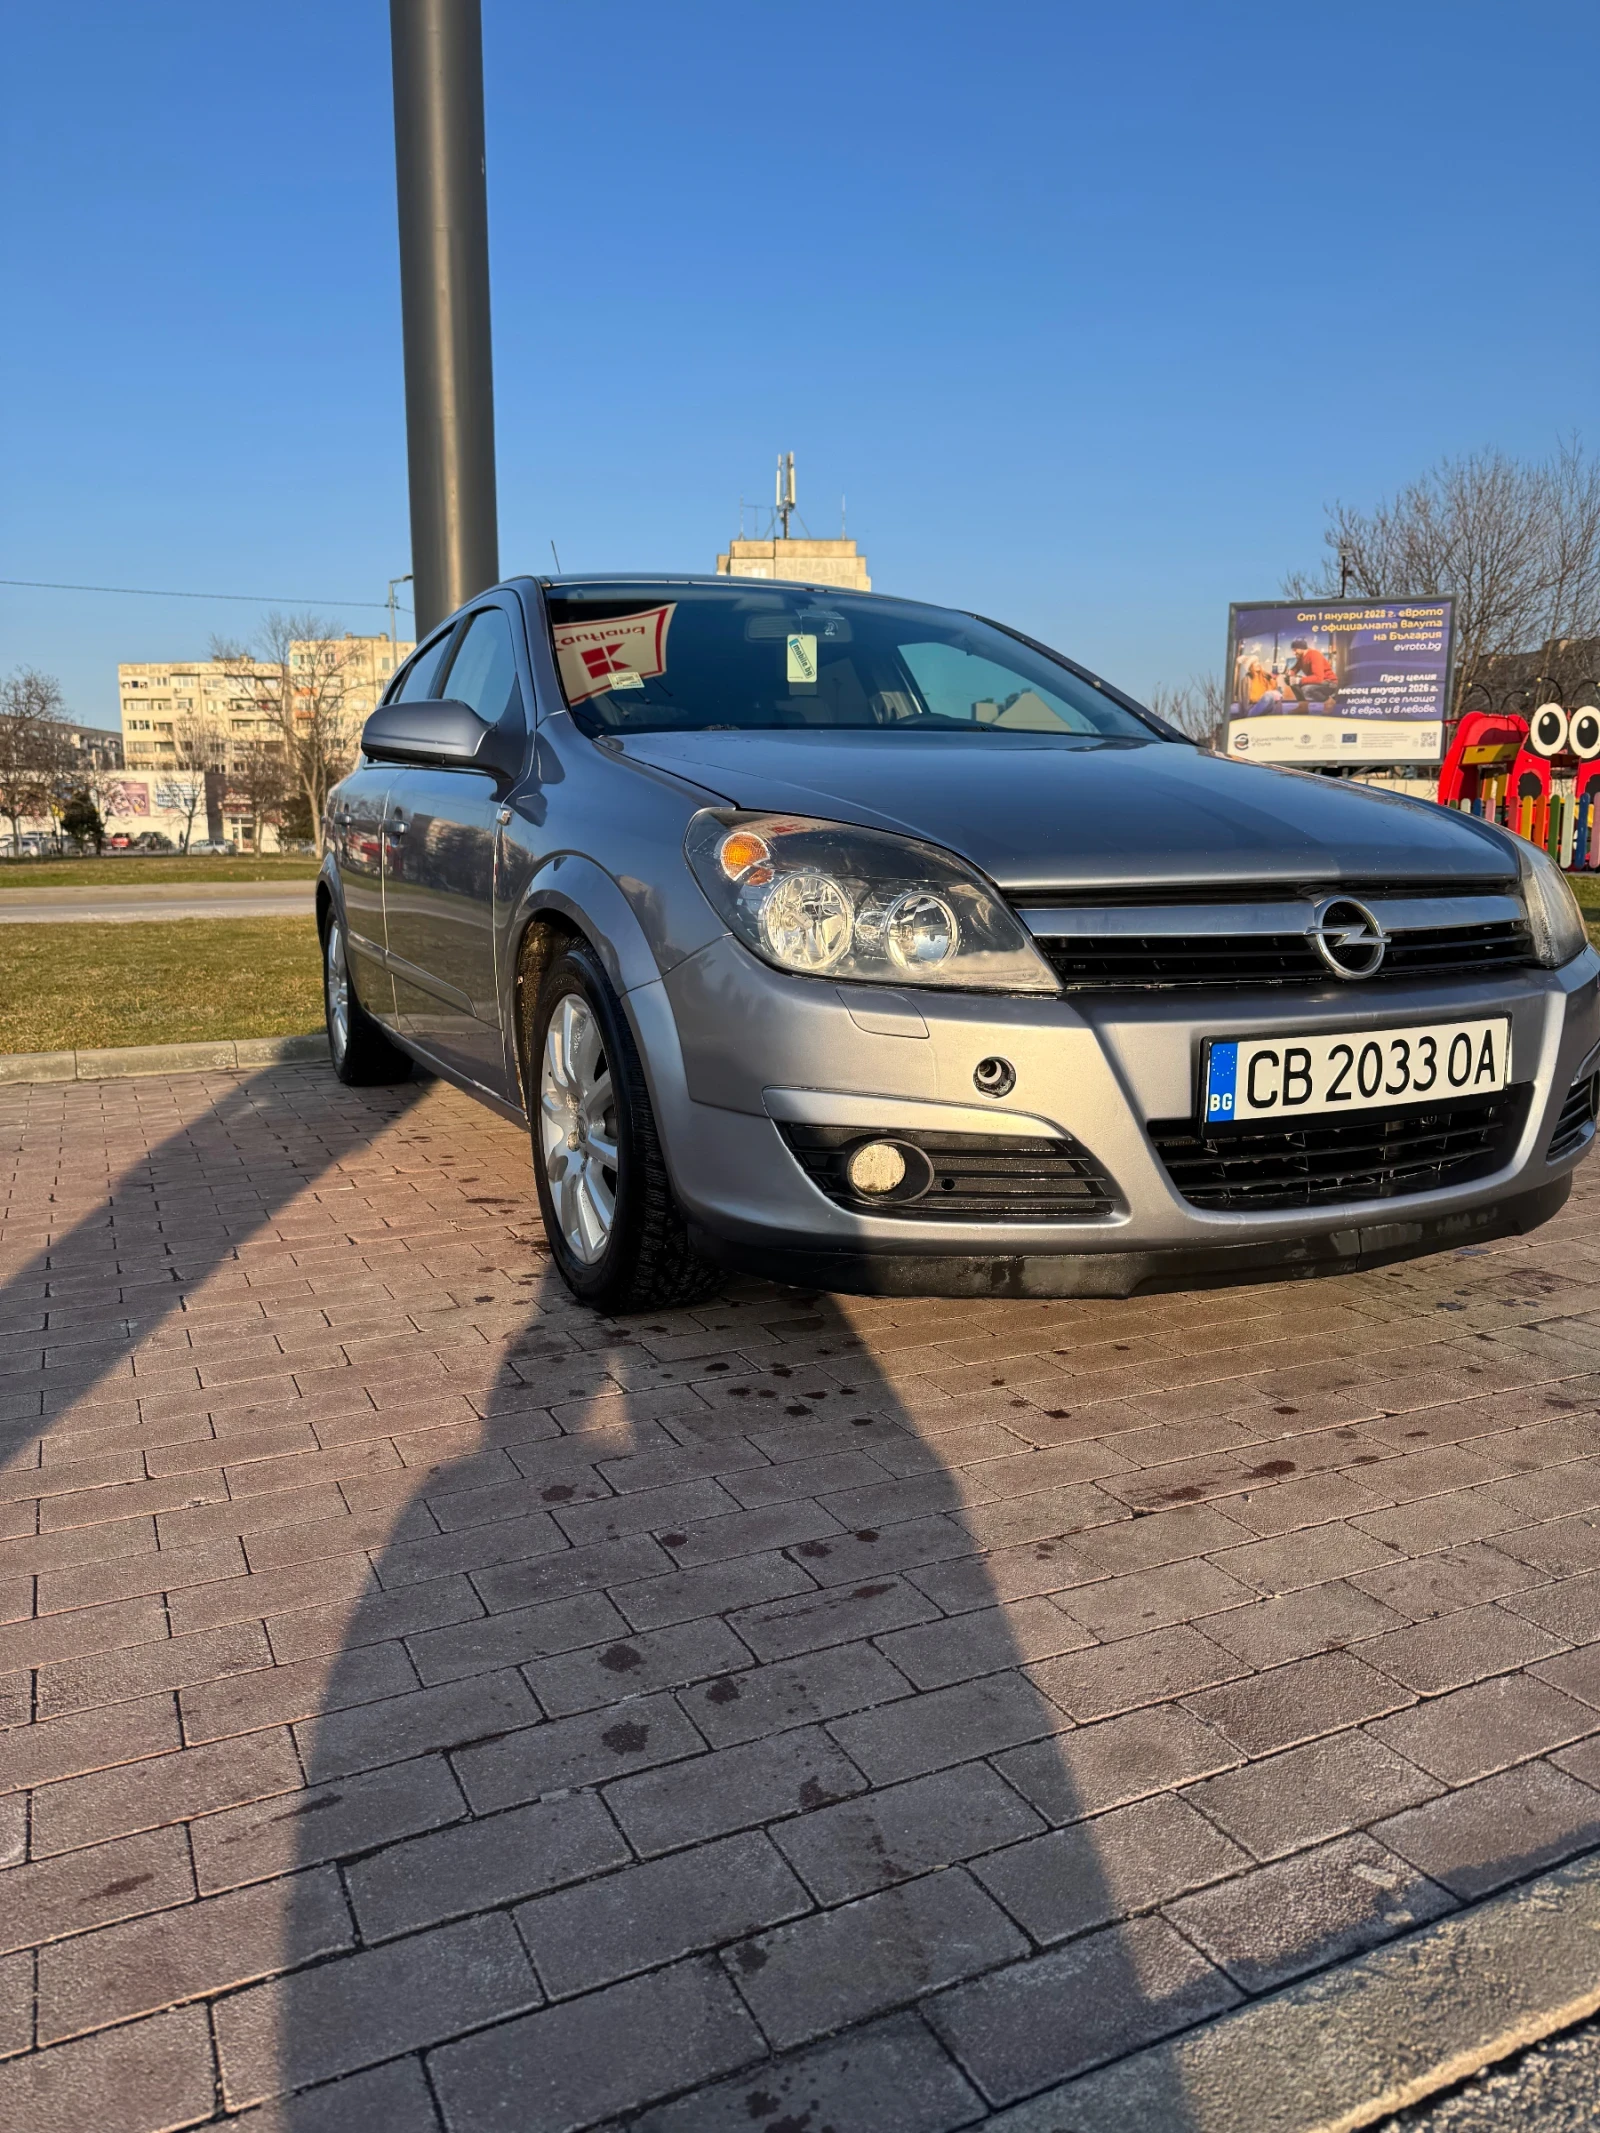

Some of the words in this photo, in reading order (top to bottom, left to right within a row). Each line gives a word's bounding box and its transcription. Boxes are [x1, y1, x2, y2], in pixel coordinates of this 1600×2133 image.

[1297, 613, 1316, 621] От
[1318, 612, 1323, 620] 1
[1324, 612, 1362, 622] януари
[1398, 608, 1443, 618] еврото
[1321, 622, 1398, 633] официалната
[1401, 619, 1442, 629] валута
[1389, 631, 1442, 641] България
[1394, 641, 1442, 651] evroto.bg
[793, 644, 813, 677] mobile.bg
[1380, 674, 1404, 683] През
[1406, 673, 1437, 682] целия
[1338, 687, 1369, 695] месец
[1370, 686, 1407, 695] януари
[1408, 684, 1429, 693] 2026
[1374, 697, 1387, 705] да
[1389, 696, 1400, 704] се
[1402, 695, 1436, 704] плаща
[1341, 707, 1348, 715] и
[1350, 706, 1356, 714] в
[1393, 705, 1400, 713] в
[1246, 1047, 1313, 1109] CB
[1325, 1036, 1437, 1103] 2033
[1209, 1093, 1233, 1112] BG
